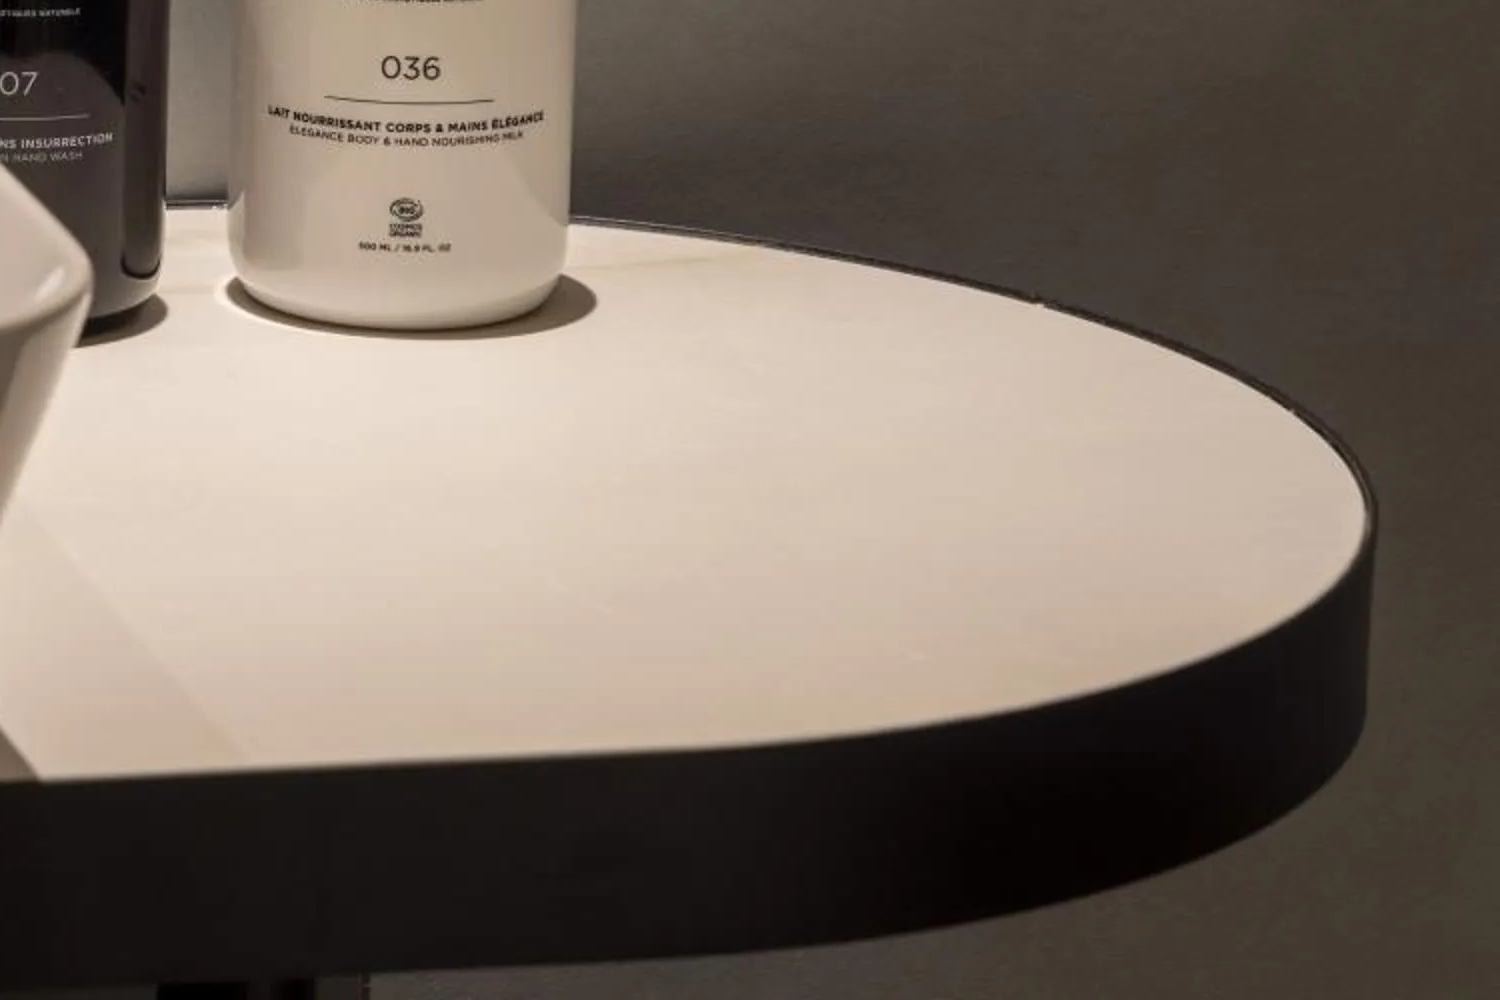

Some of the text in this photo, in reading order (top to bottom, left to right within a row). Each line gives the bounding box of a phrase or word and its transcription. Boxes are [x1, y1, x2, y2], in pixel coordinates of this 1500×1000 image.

[381, 55, 441, 81] 036
[267, 104, 290, 119] LAIT
[293, 111, 381, 132] NOURRISSANT
[385, 122, 432, 133] CORPS
[435, 123, 443, 133] &
[448, 120, 488, 132] MAINS
[20, 131, 114, 149] INSURRECTION
[347, 133, 379, 145] BODY
[383, 136, 391, 146] &
[395, 137, 428, 147] HAND
[432, 134, 500, 147] NOURISHING
[12, 151, 47, 163] HAND
[49, 150, 83, 162] WASH
